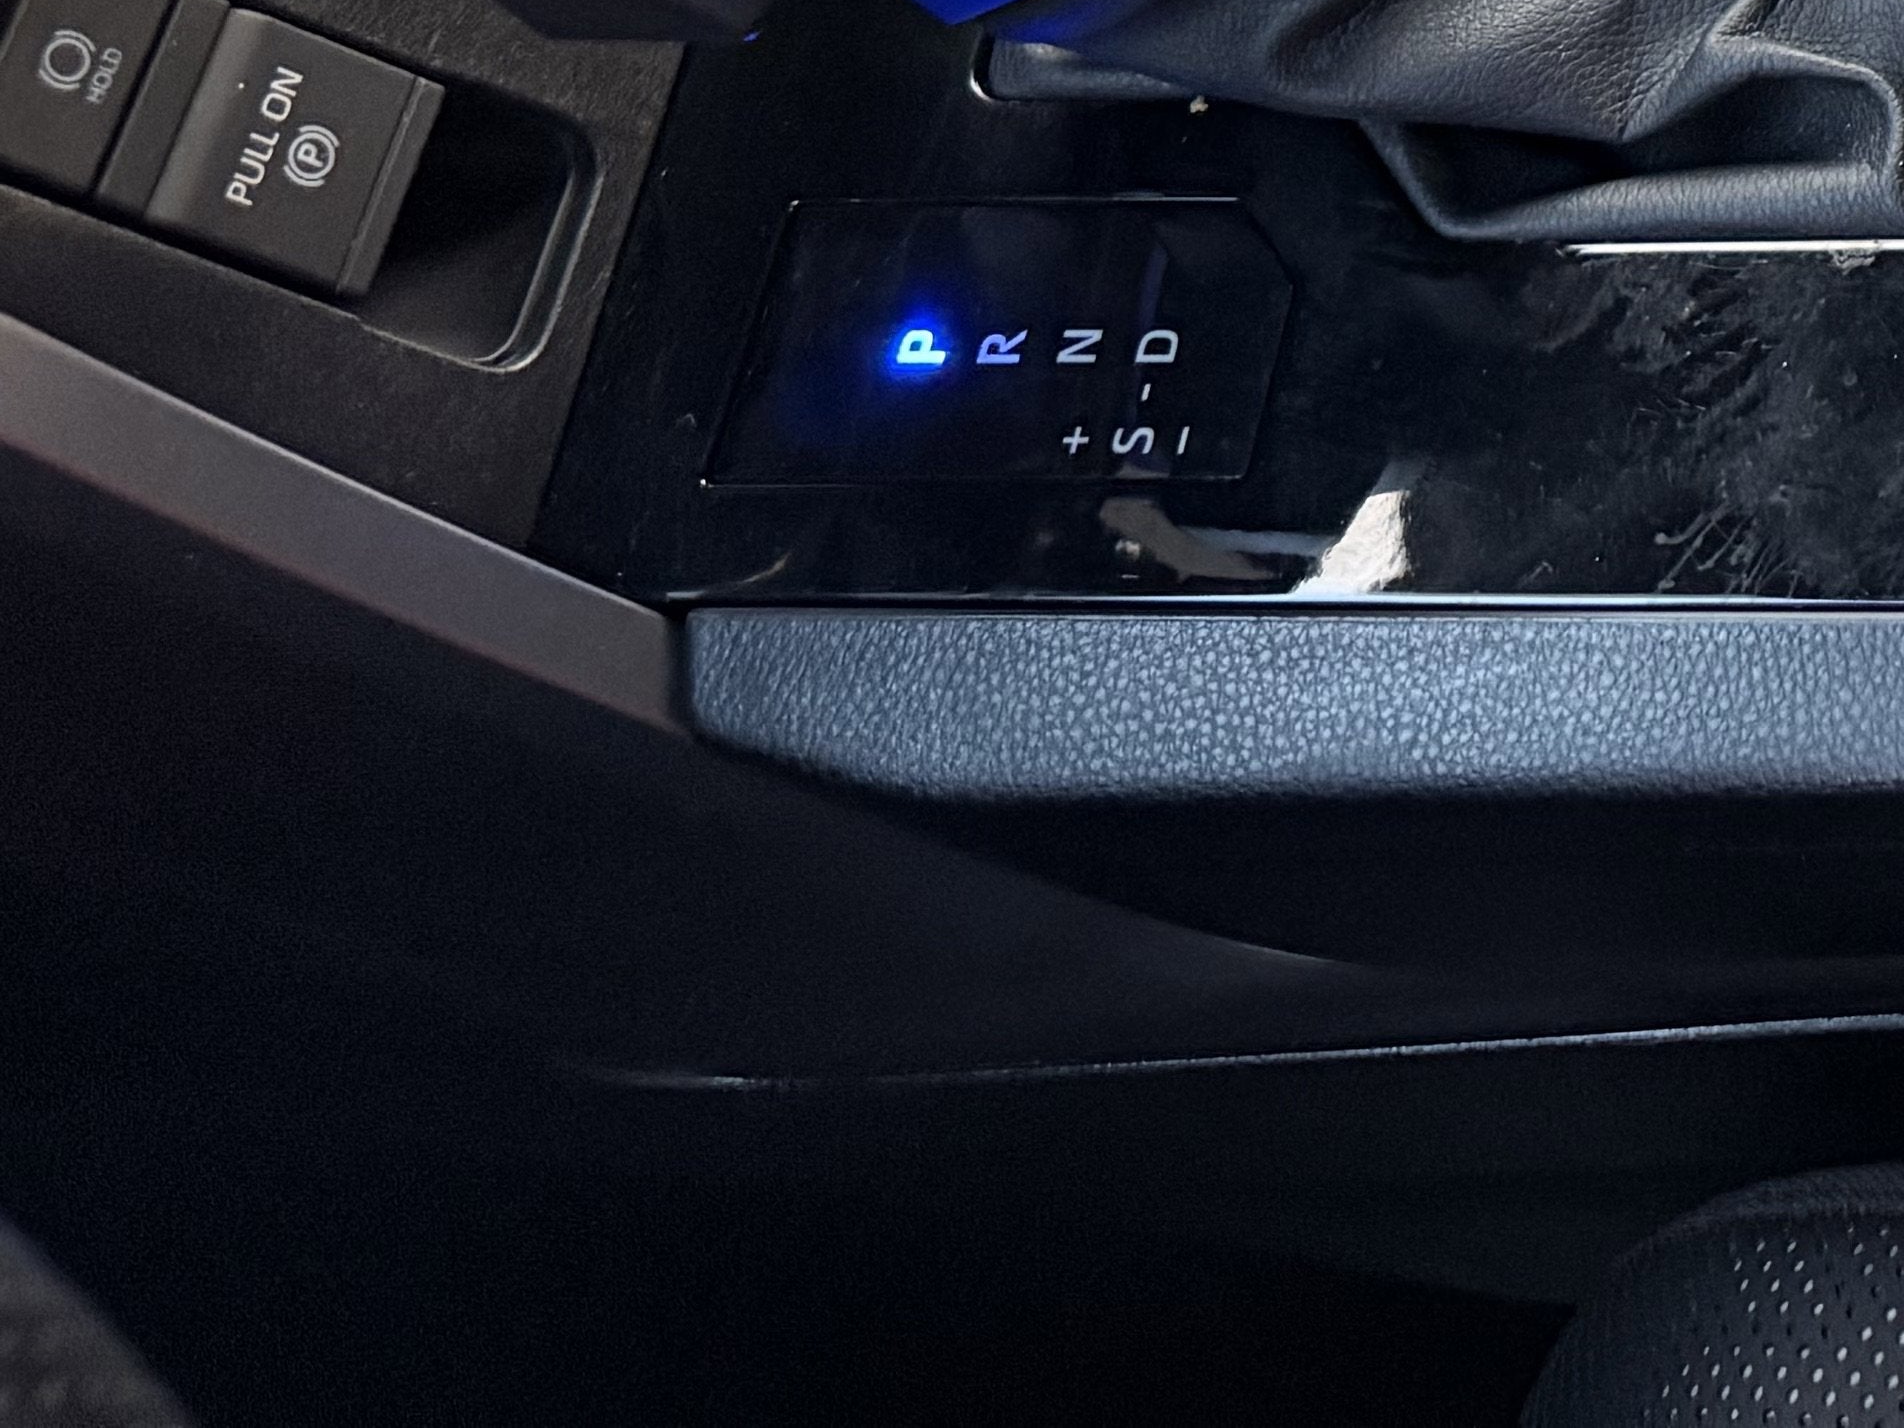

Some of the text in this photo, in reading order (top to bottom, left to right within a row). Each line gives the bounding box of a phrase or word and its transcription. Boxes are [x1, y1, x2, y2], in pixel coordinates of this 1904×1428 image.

[86, 47, 122, 104] HOLD
[224, 66, 303, 206] PULL ON
[897, 329, 946, 364] P
[976, 329, 1028, 364] R
[1056, 329, 1103, 364] N
[1135, 329, 1179, 363] D
